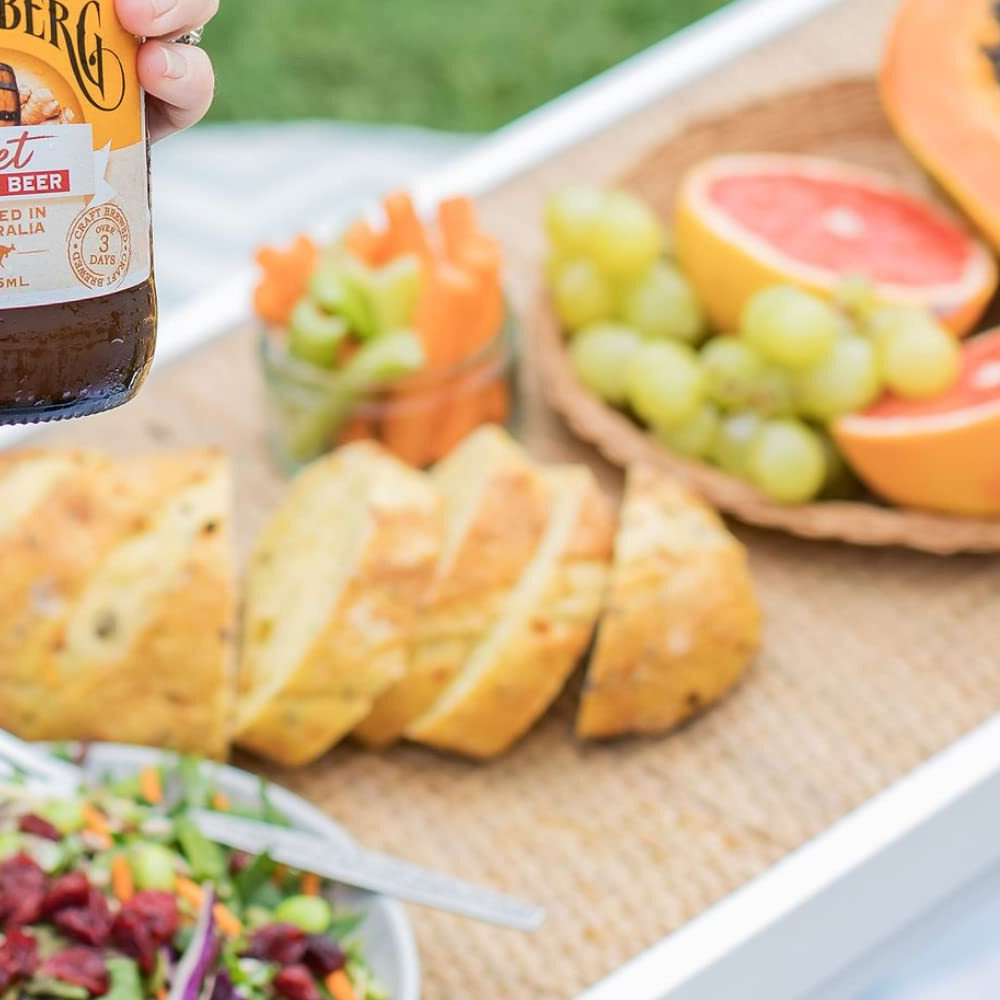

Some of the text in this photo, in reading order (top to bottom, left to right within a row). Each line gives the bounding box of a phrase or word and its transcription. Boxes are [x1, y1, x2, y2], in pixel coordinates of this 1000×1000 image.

[7, 173, 62, 192] BEER
[28, 206, 47, 219] IN
[74, 206, 129, 243] CRAFT BREWED
[95, 223, 115, 236] OVER
[98, 234, 109, 253] 3
[89, 254, 116, 265] DAYS
[72, 251, 128, 288] CRAFT BREWED
